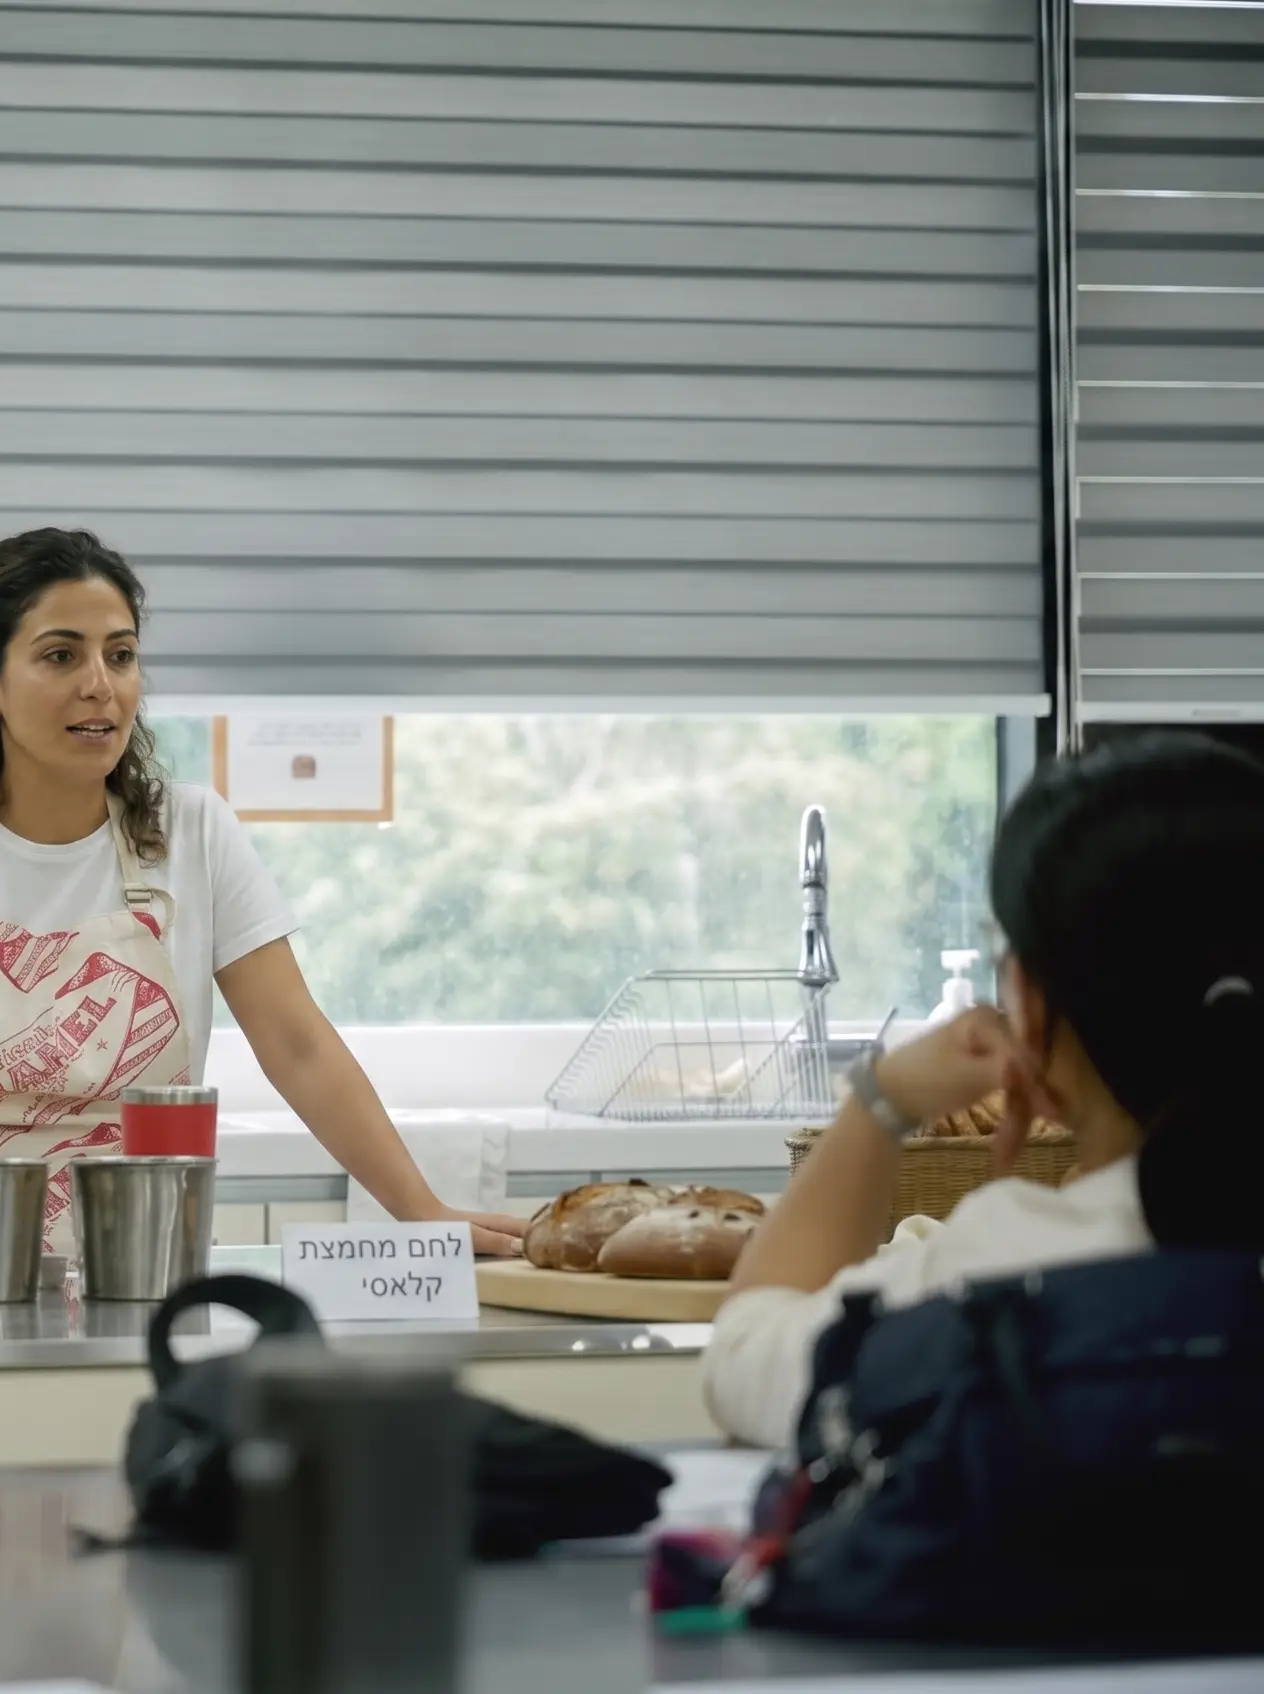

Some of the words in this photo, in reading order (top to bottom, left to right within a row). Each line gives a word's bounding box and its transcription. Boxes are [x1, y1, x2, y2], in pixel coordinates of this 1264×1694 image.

[299, 1239, 396, 1260] מחמצת
[408, 1232, 462, 1258] לחם
[362, 1271, 443, 1302] קלאסי
